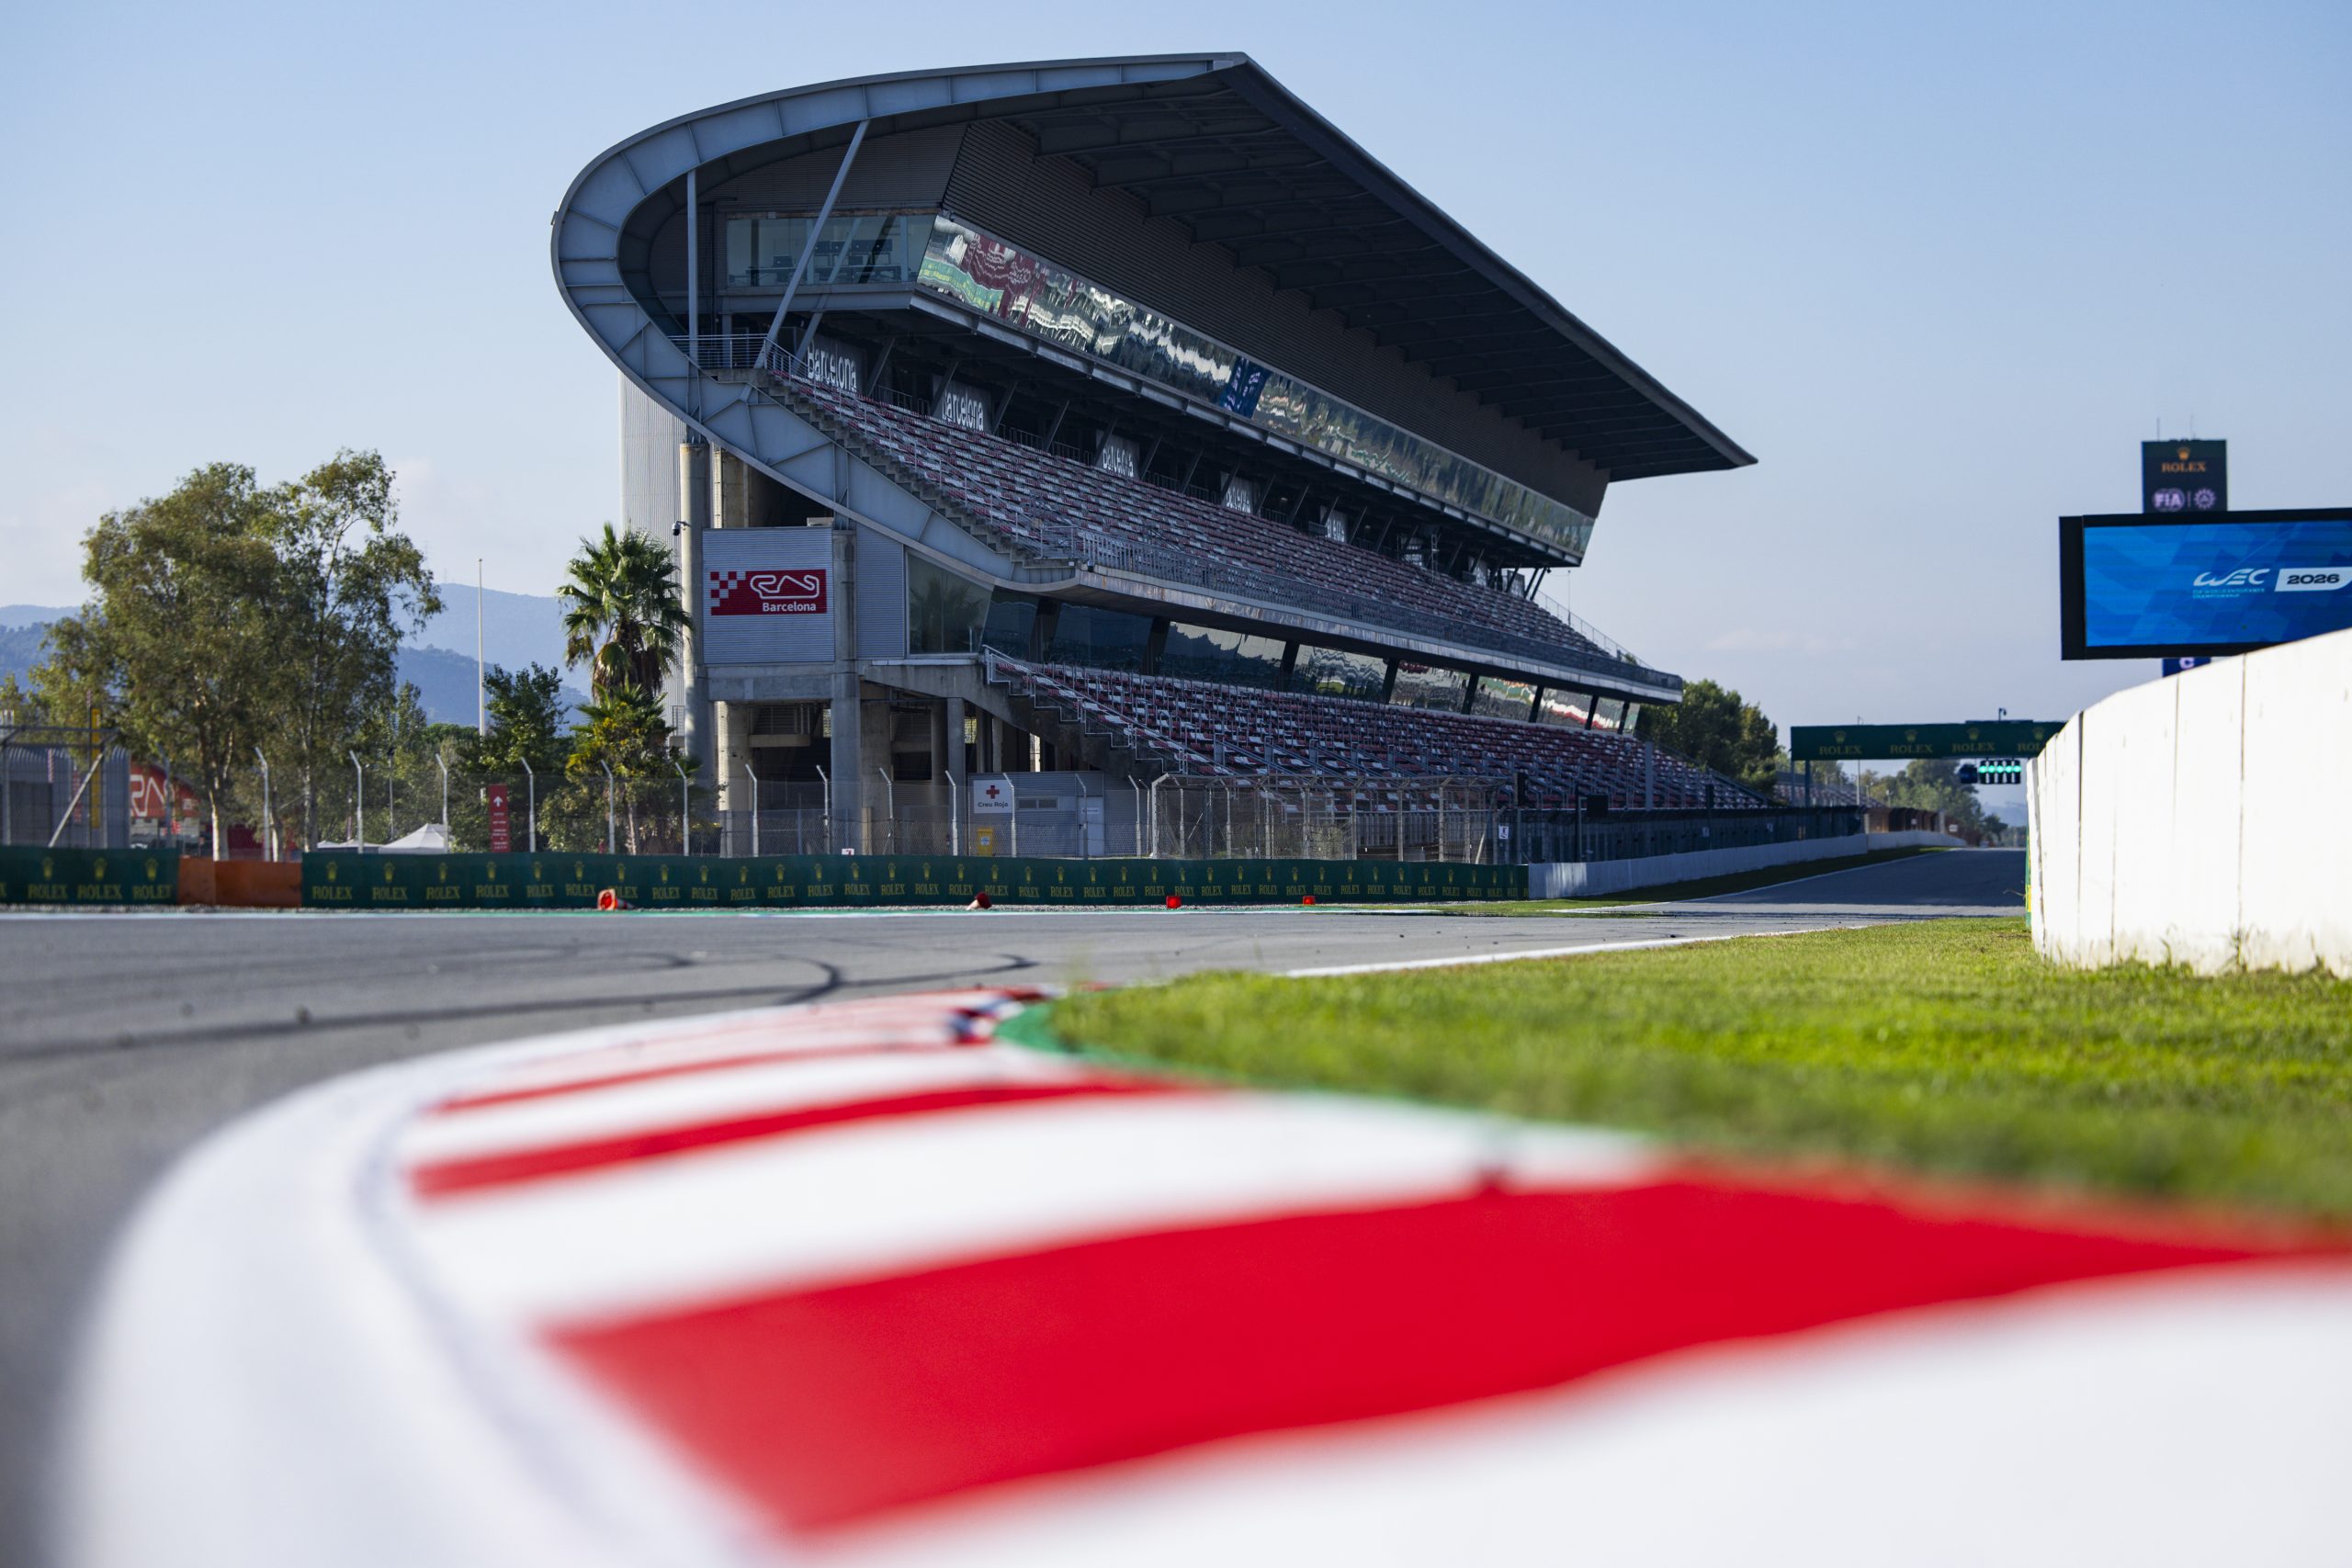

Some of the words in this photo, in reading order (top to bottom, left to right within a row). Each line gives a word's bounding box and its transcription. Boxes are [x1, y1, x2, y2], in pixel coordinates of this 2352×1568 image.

[808, 338, 857, 393] Barcelona
[2161, 461, 2206, 473] ROLEX
[2154, 491, 2183, 508] FIA
[2193, 568, 2270, 587] WEC
[2287, 573, 2340, 585] 2026
[763, 601, 817, 612] Barcelona
[1818, 746, 1861, 755] ROLEX
[1890, 743, 1933, 754] ROLEX
[1951, 741, 1996, 753] ROLEX
[28, 885, 68, 899] ROLEX
[77, 885, 122, 899] ROLEX
[312, 886, 353, 900] ROLEX
[372, 886, 408, 900] ROLEX
[426, 886, 460, 899] ROLEX
[476, 885, 509, 898] ROLEX
[566, 884, 595, 897] ROLEX
[652, 886, 681, 899] ROLEX
[691, 886, 718, 899] ROLEX
[730, 888, 756, 900] ROLEX
[767, 886, 795, 898] ROLEX
[808, 885, 834, 897] ROLEX
[844, 884, 870, 896] ROLEX
[881, 883, 905, 897] ROLEX
[915, 884, 940, 896] ROLEX
[948, 884, 974, 896] ROLEX
[1018, 886, 1040, 898] ROLEX
[1050, 886, 1073, 897] ROLEX
[1084, 886, 1106, 897] ROLEX
[1113, 886, 1136, 897] ROLEX
[1144, 886, 1165, 897] ROLEX
